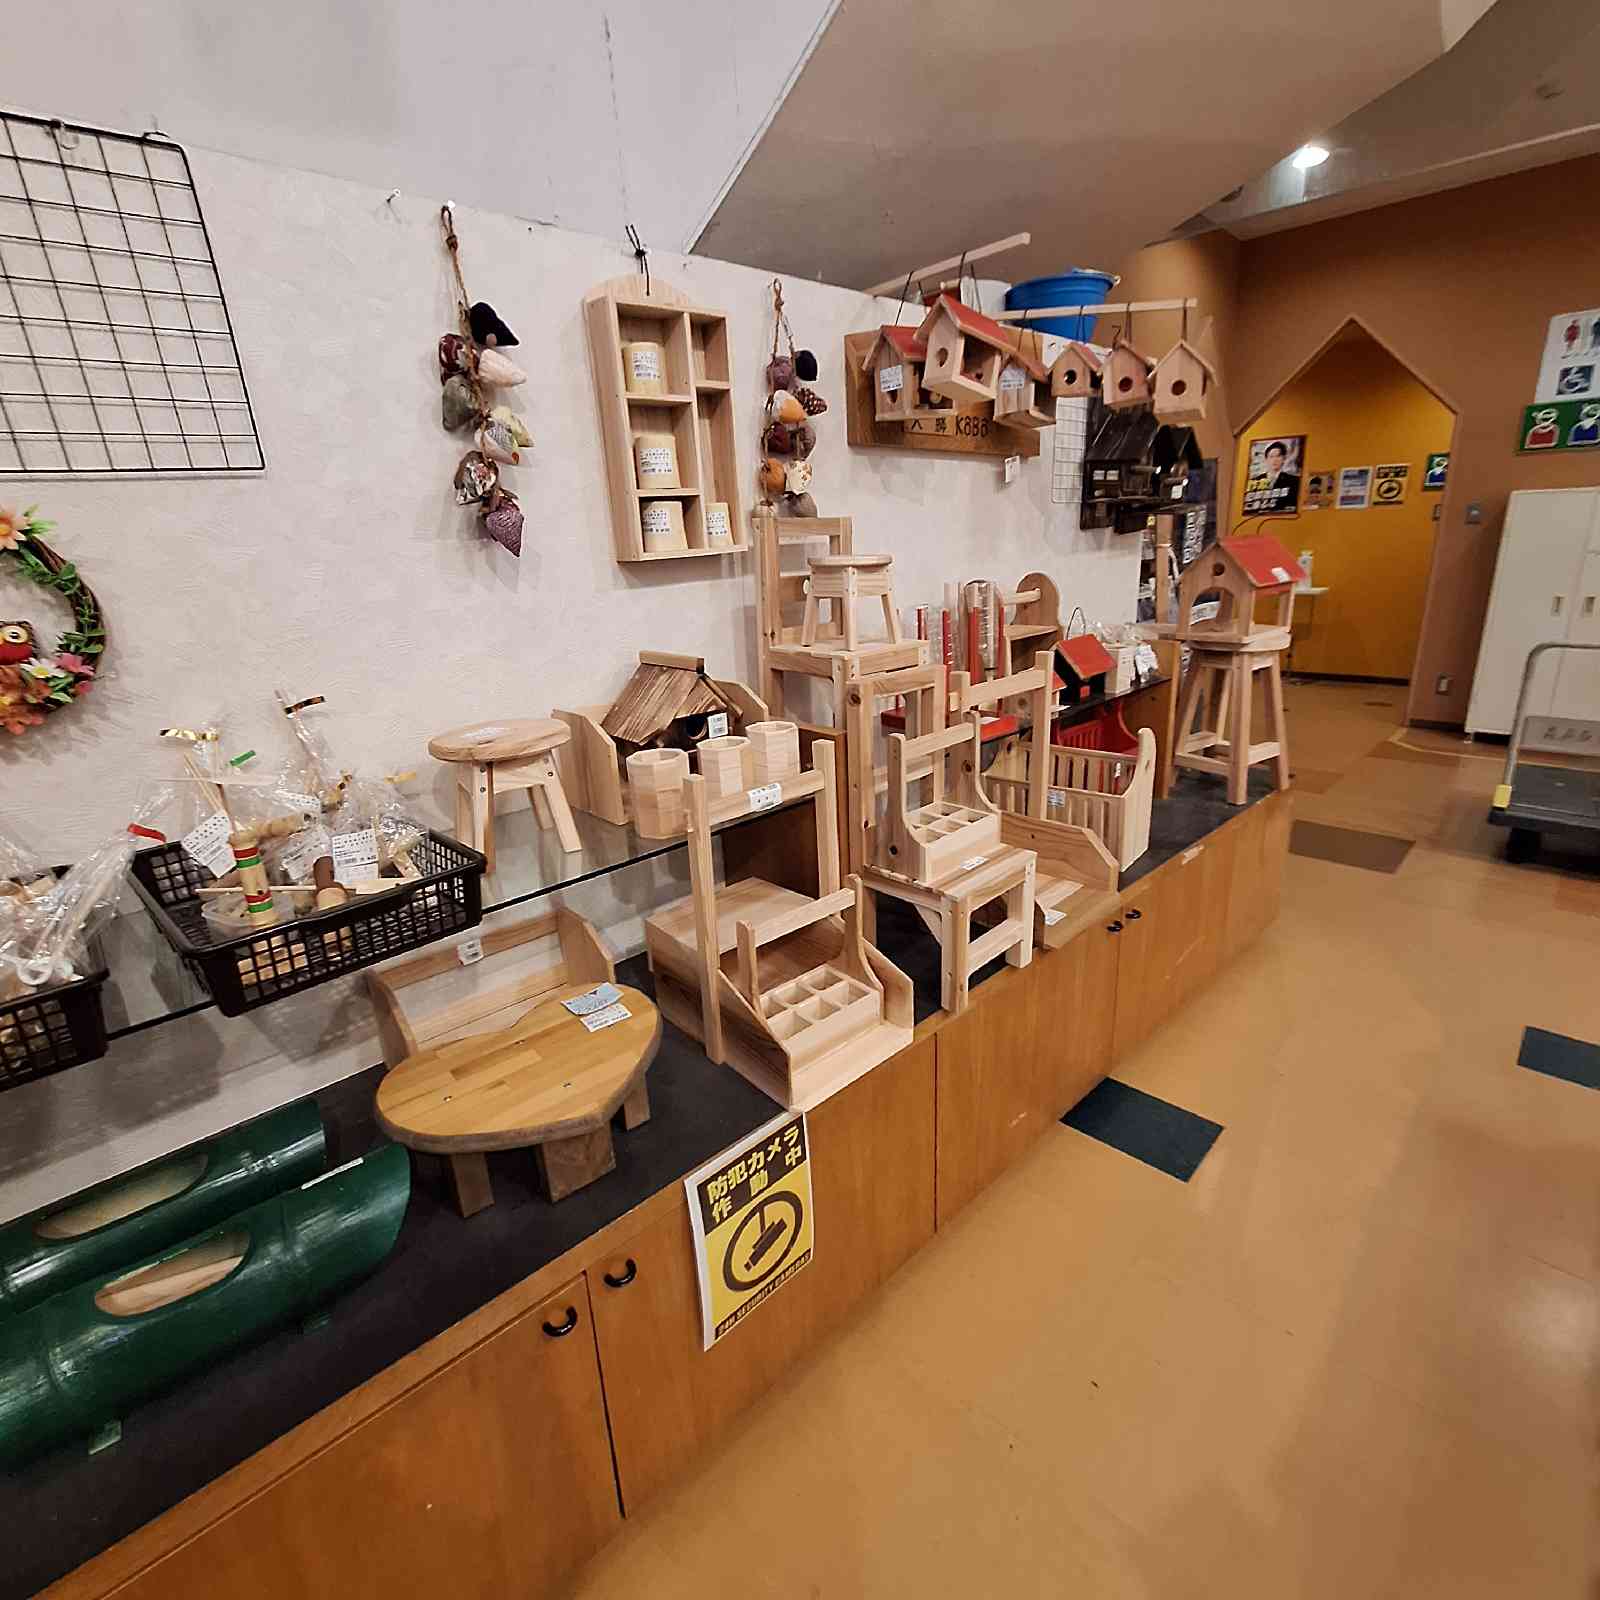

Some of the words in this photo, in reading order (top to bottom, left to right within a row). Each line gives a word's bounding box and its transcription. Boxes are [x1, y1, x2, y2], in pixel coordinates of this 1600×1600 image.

[706, 1125, 799, 1205] 防犯カメラ
[736, 1281, 775, 1320] SECURITY
